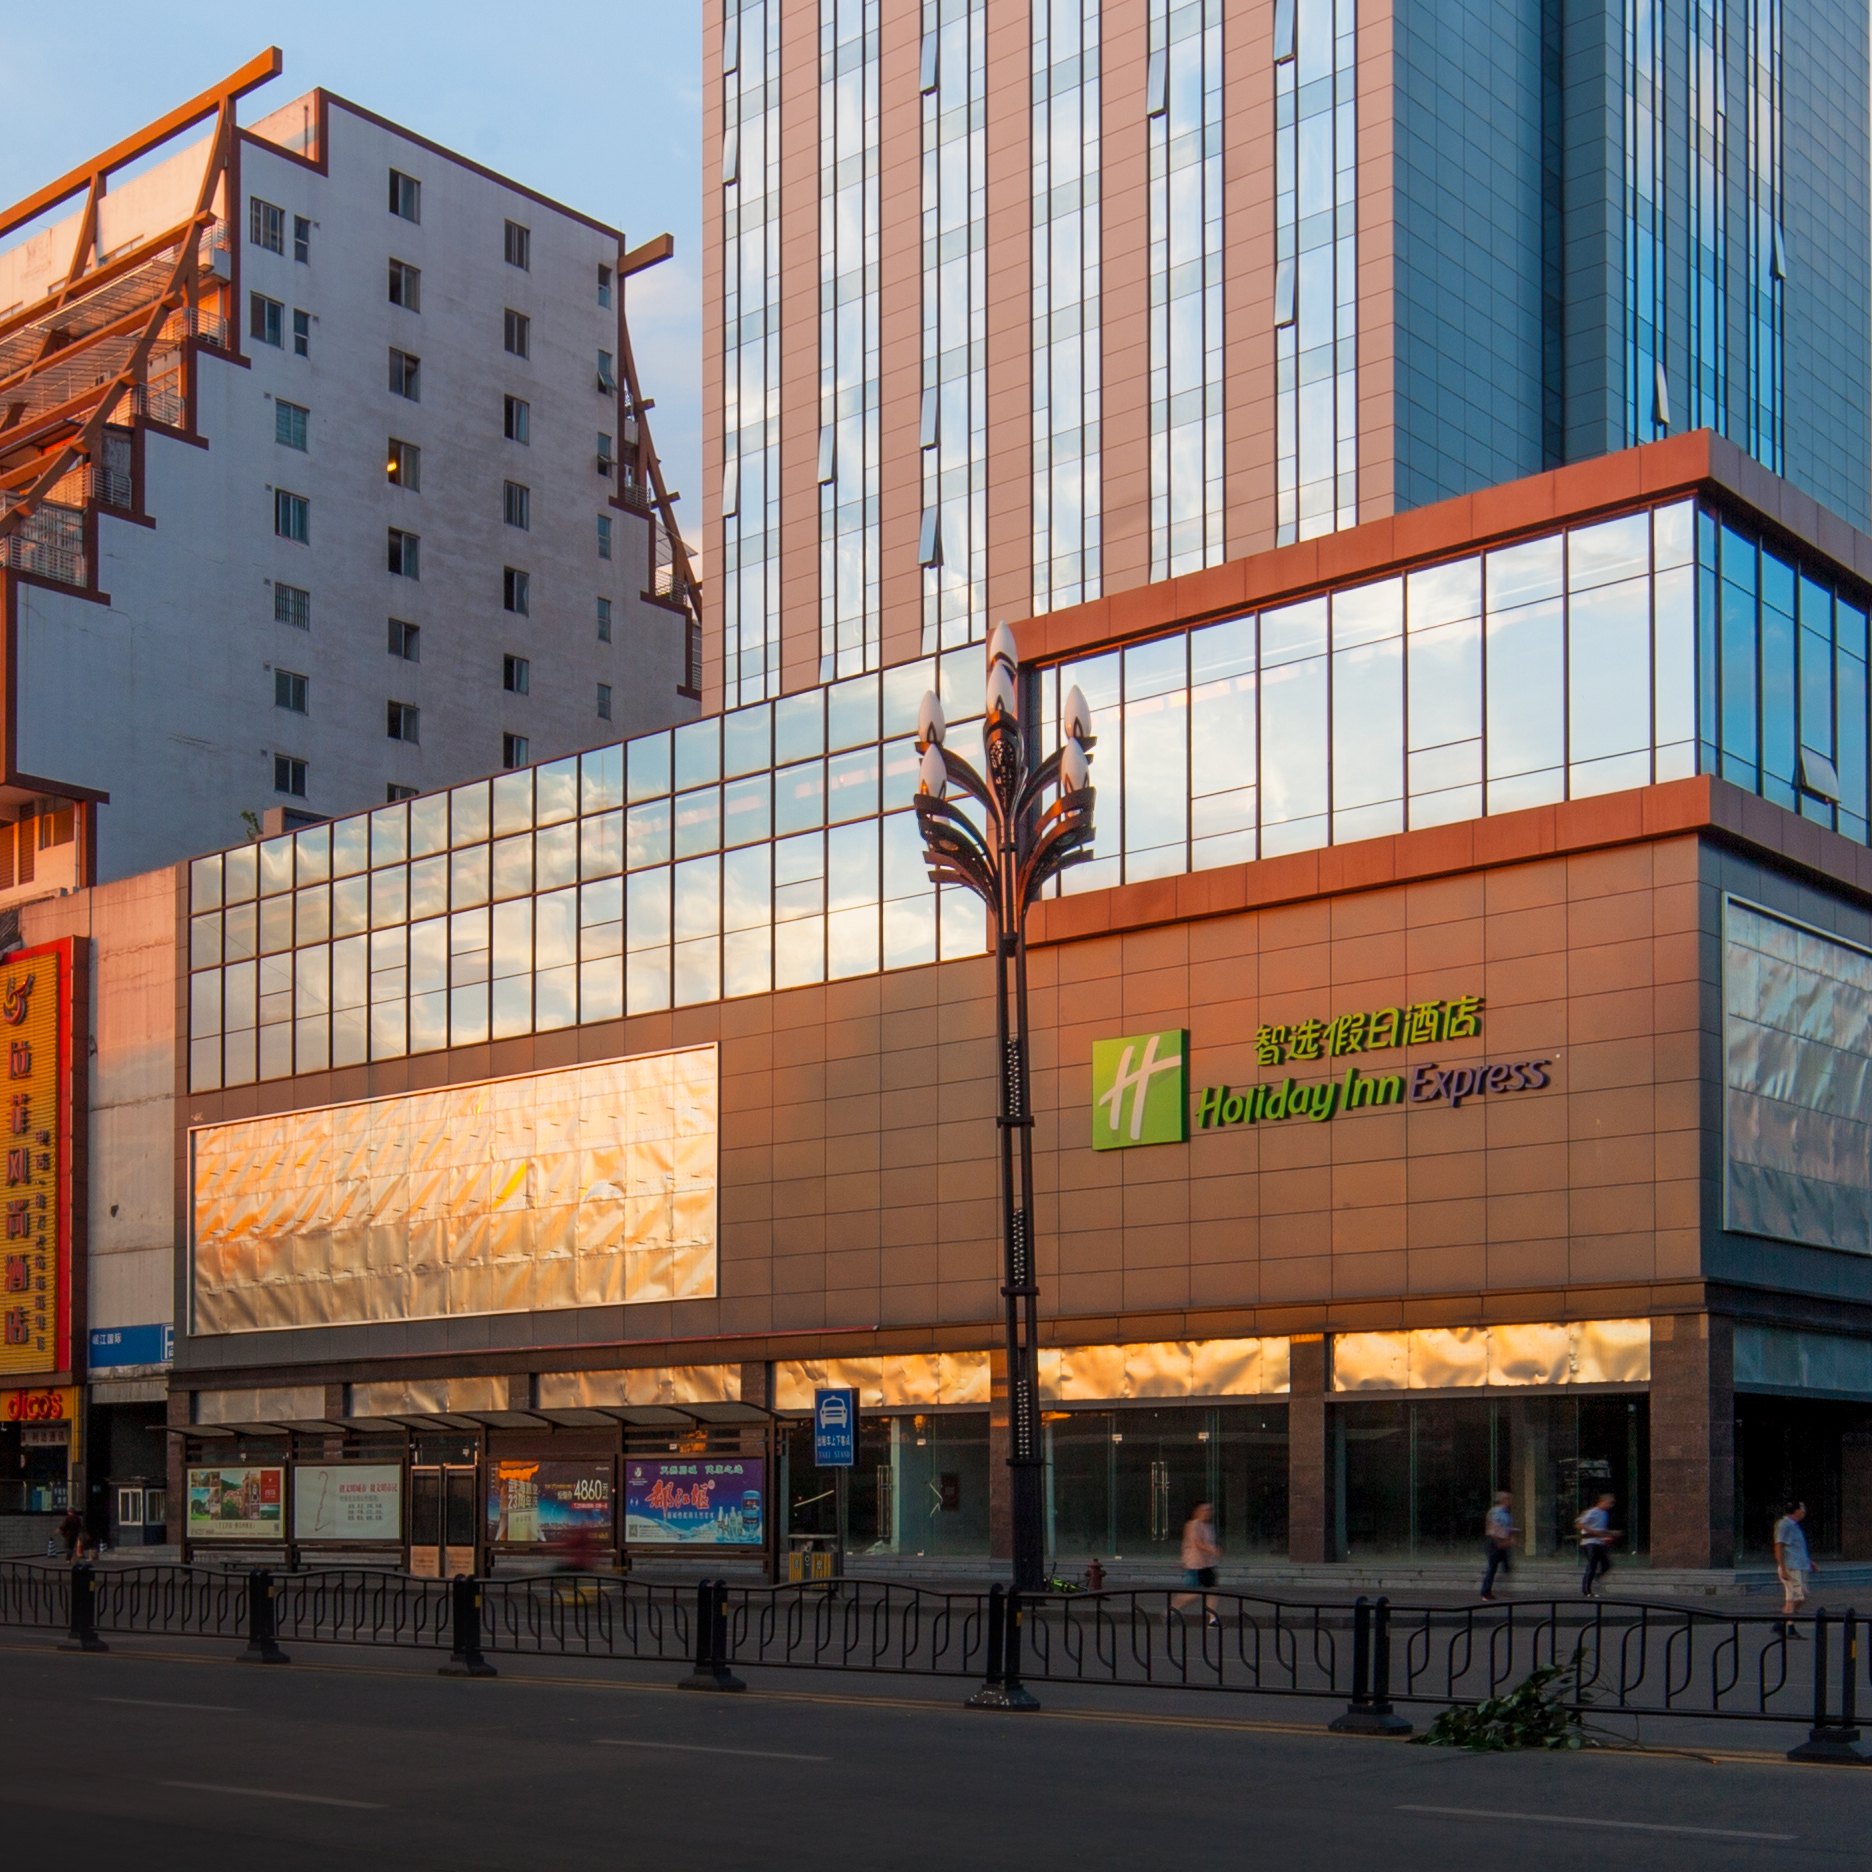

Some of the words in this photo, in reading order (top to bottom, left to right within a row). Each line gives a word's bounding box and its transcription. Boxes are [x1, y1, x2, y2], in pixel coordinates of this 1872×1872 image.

[1253, 996, 1484, 1067] 智选假日酒店
[1195, 1079, 1335, 1128] Holiday
[1343, 1068, 1404, 1112] Inn
[1408, 1057, 1552, 1106] Express
[8, 1388, 63, 1420] dico's
[574, 1479, 602, 1500] 4860
